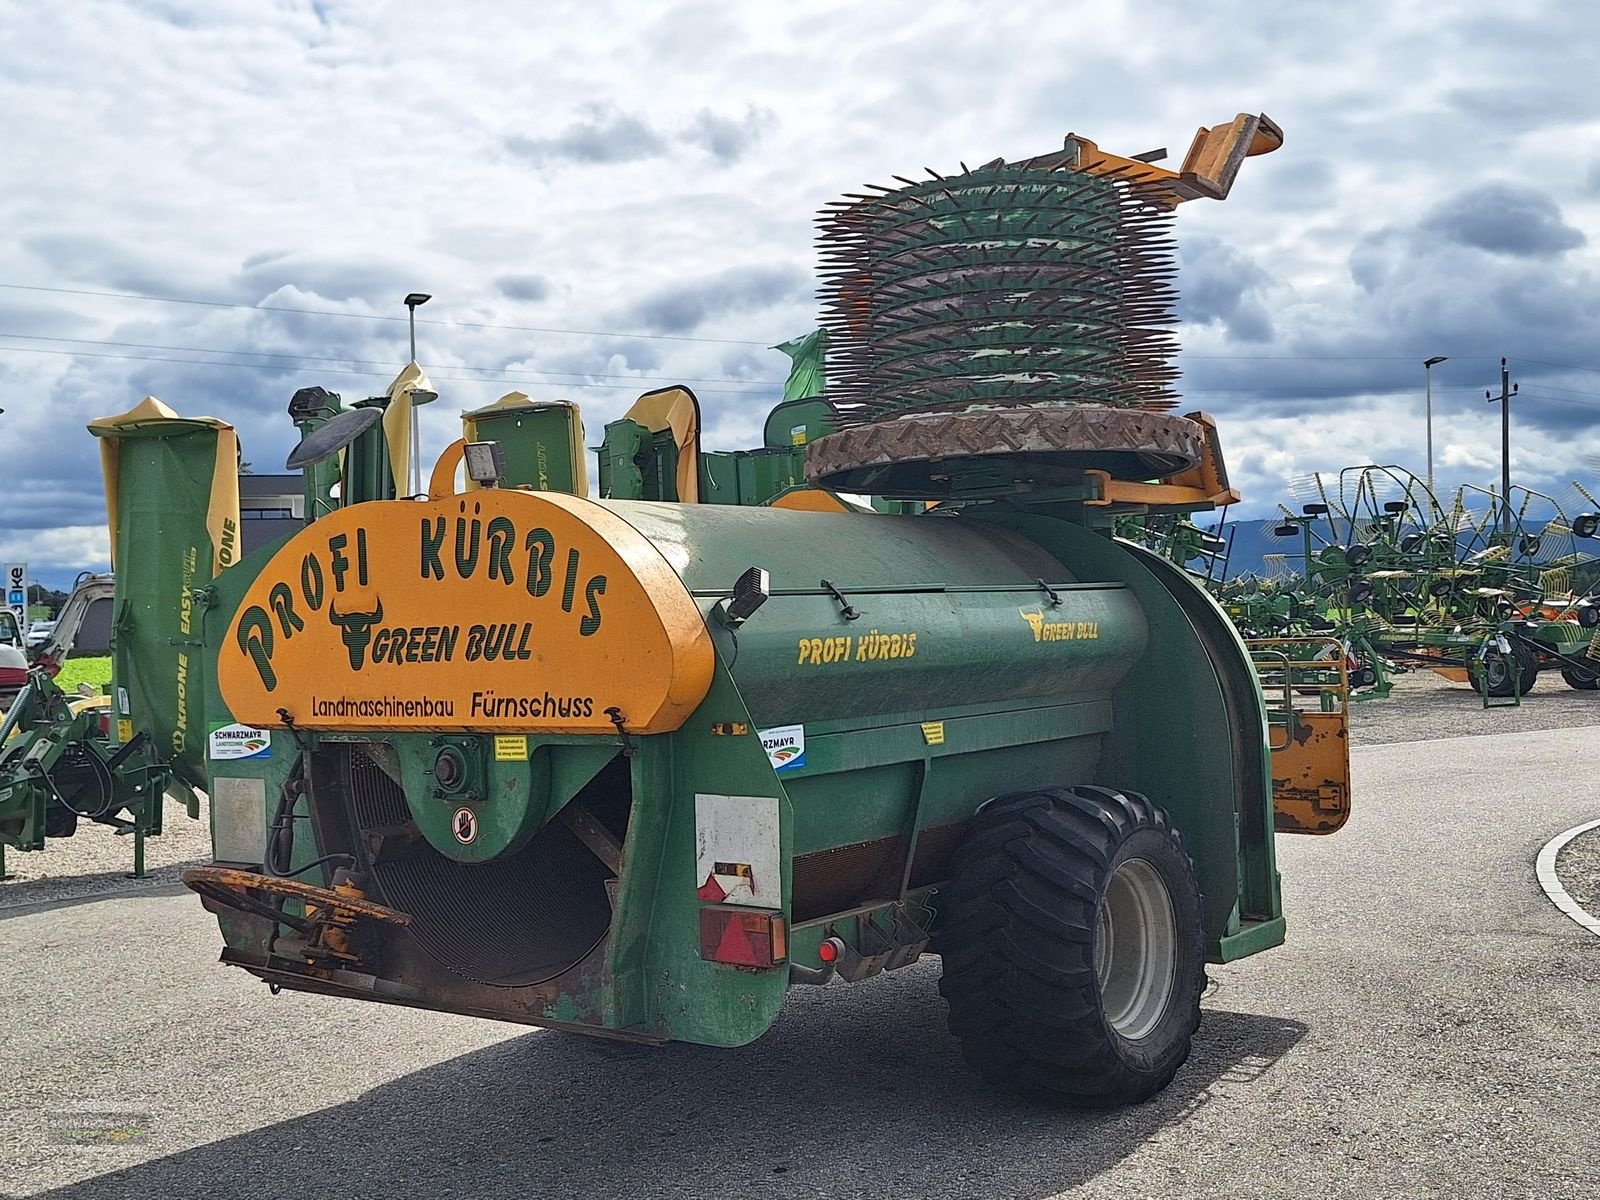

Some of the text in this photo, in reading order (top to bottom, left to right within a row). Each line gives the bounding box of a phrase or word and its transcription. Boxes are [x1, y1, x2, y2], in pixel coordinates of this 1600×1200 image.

[219, 517, 236, 567] ONE
[237, 500, 607, 692] PROFI KÜRBIS
[371, 622, 533, 664] GREEN BULL
[798, 629, 917, 665] PROFI KÜRBIS
[1043, 621, 1098, 641] GREEN BULL
[177, 652, 188, 730] KRONE
[312, 690, 594, 719] Landmaschinenbau Fürnschuss
[214, 730, 262, 740] SCHWARZMAYR
[763, 737, 795, 749] RZMAYR
